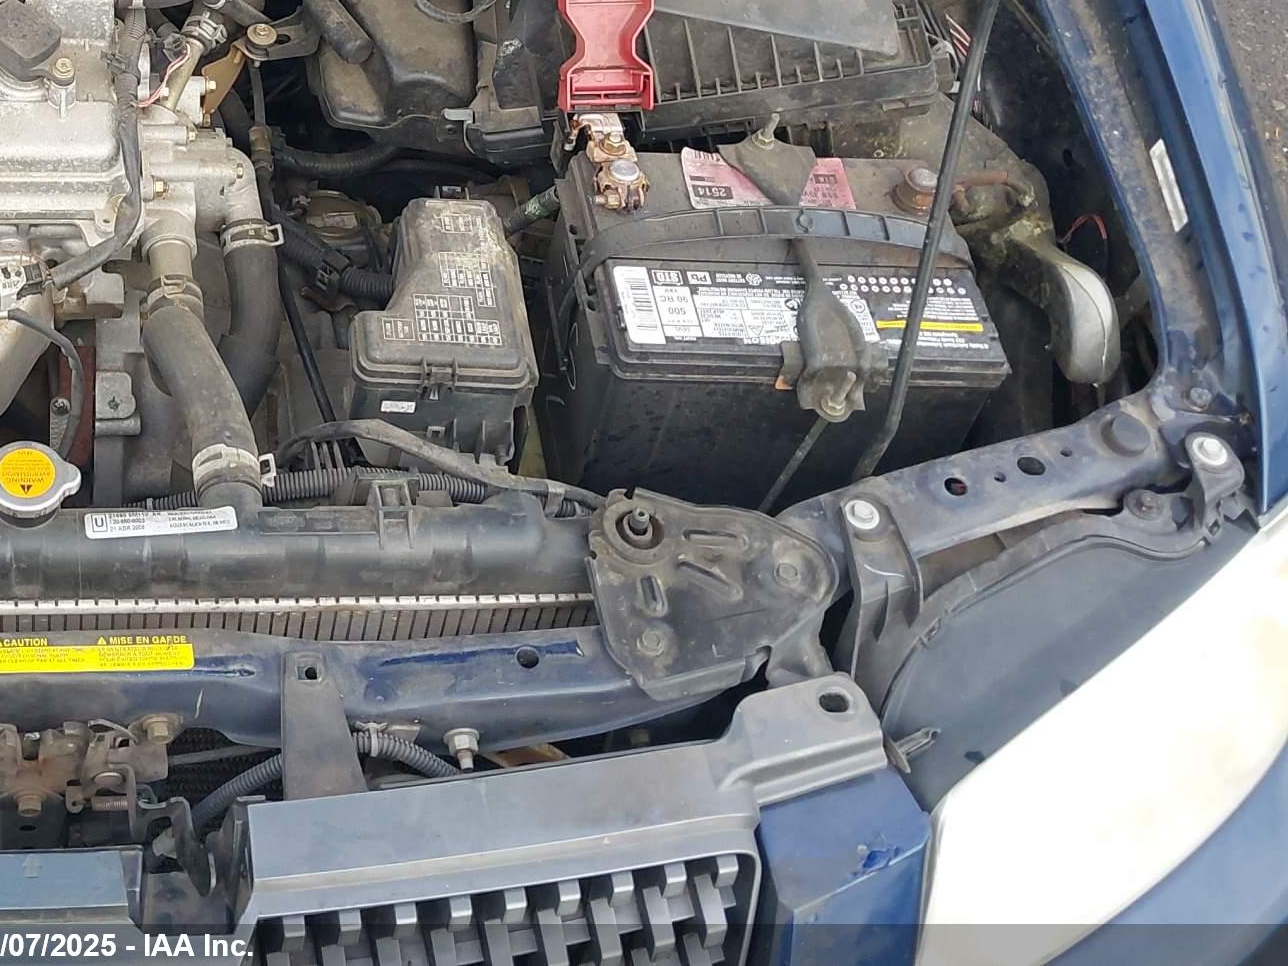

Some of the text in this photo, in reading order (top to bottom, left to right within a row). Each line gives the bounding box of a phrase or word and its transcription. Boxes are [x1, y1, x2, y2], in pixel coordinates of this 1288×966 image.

[697, 187, 727, 198] 2514
[690, 273, 707, 282] Pb
[95, 516, 104, 527] U
[3, 638, 48, 647] CAUTION
[109, 635, 188, 645] MISE EN GARDE
